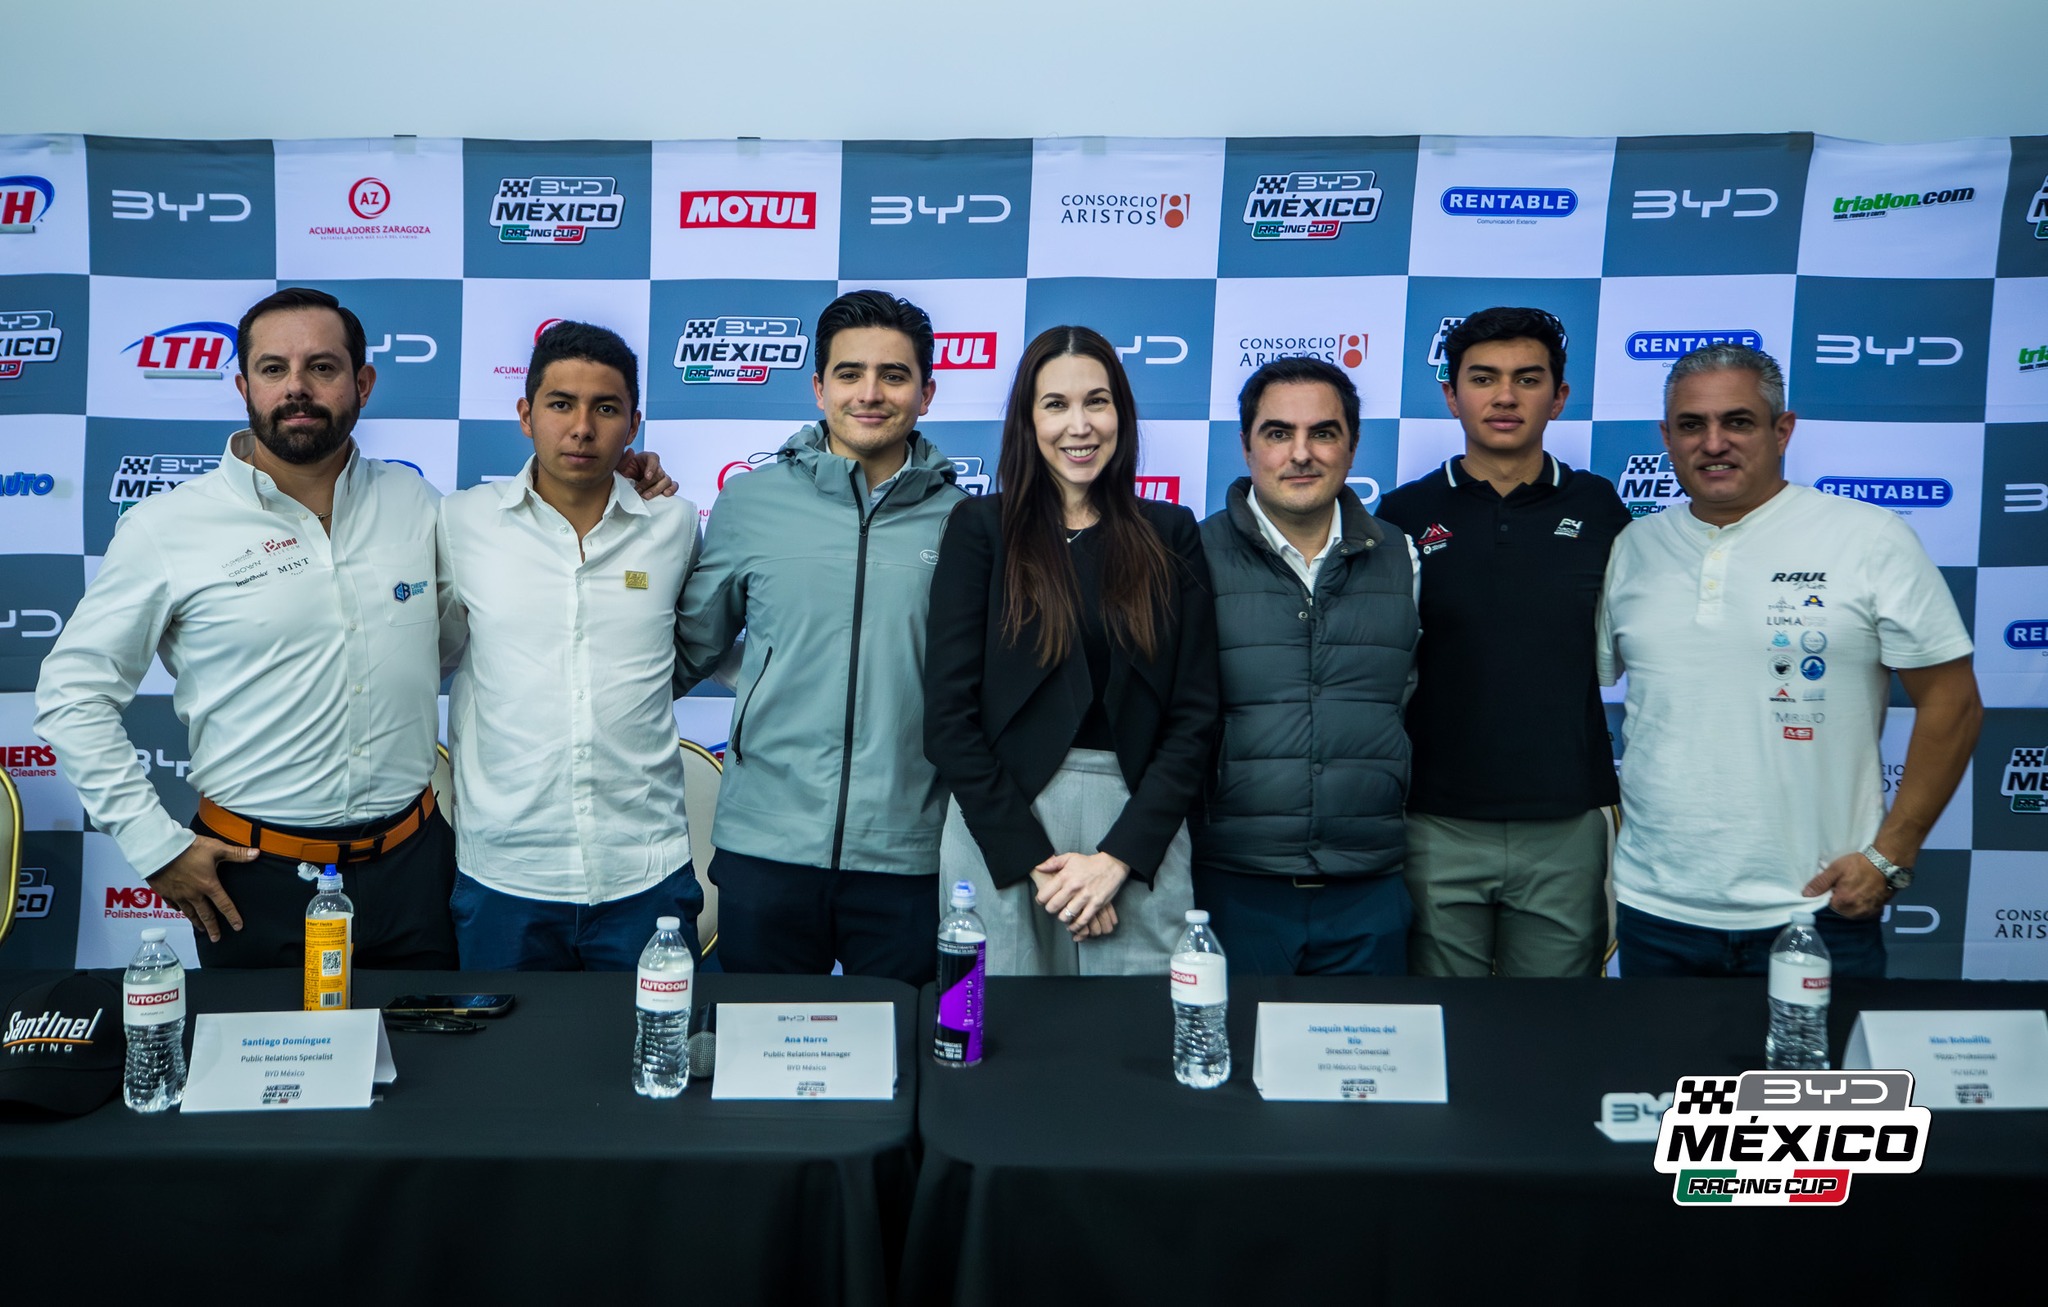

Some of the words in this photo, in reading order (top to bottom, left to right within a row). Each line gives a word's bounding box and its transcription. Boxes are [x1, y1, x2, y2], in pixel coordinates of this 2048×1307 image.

[540, 181, 602, 194] BYD
[1297, 176, 1362, 190] BYD
[360, 191, 380, 206] AZ
[1061, 194, 1158, 208] CONSORCIO
[1450, 193, 1570, 210] RENTABLE
[1632, 188, 1779, 219] BYD
[1833, 186, 1975, 214] triatlon.com
[111, 189, 251, 223] BYD
[496, 198, 618, 222] MÉXICO
[686, 195, 811, 224] MOTUL
[870, 194, 1012, 225] BYD
[1250, 194, 1372, 218] MÉXICO
[1061, 209, 1156, 225] ARISTOS
[309, 226, 380, 235] ACUMULADORES
[382, 225, 431, 234] ZARAGOZA
[505, 228, 552, 238] RACING
[552, 229, 580, 238] CUP
[1257, 225, 1307, 235] RACING
[1306, 223, 1336, 234] CUP
[0, 316, 41, 329] YD
[725, 321, 788, 335] BYD
[1239, 337, 1336, 349] CONSORCIO
[1815, 334, 1964, 366] BYD
[137, 336, 224, 369] LTH
[680, 338, 799, 363] MÉXICO
[688, 369, 736, 379] RACING
[736, 370, 764, 379] CUP
[228, 560, 262, 578] CROWN
[277, 557, 310, 574] MINT
[1770, 572, 1828, 582] RAUL
[1766, 616, 1804, 626] LUMA
[642, 980, 686, 992] AUTOCOM
[128, 990, 178, 1005] AUTOCOM
[241, 1037, 281, 1048] Santiago
[282, 1036, 331, 1047] Domínguez
[784, 1035, 801, 1044] Ana
[803, 1035, 828, 1044] Narro
[10, 1043, 73, 1055] RACING
[763, 1050, 785, 1059] Public
[786, 1050, 819, 1059] Relations
[821, 1051, 851, 1060] Manager
[240, 1054, 263, 1063] Public
[264, 1053, 298, 1063] Relations
[299, 1053, 333, 1062] Specialist
[264, 1069, 280, 1078] BYD
[280, 1068, 305, 1078] México
[802, 1063, 827, 1072] México
